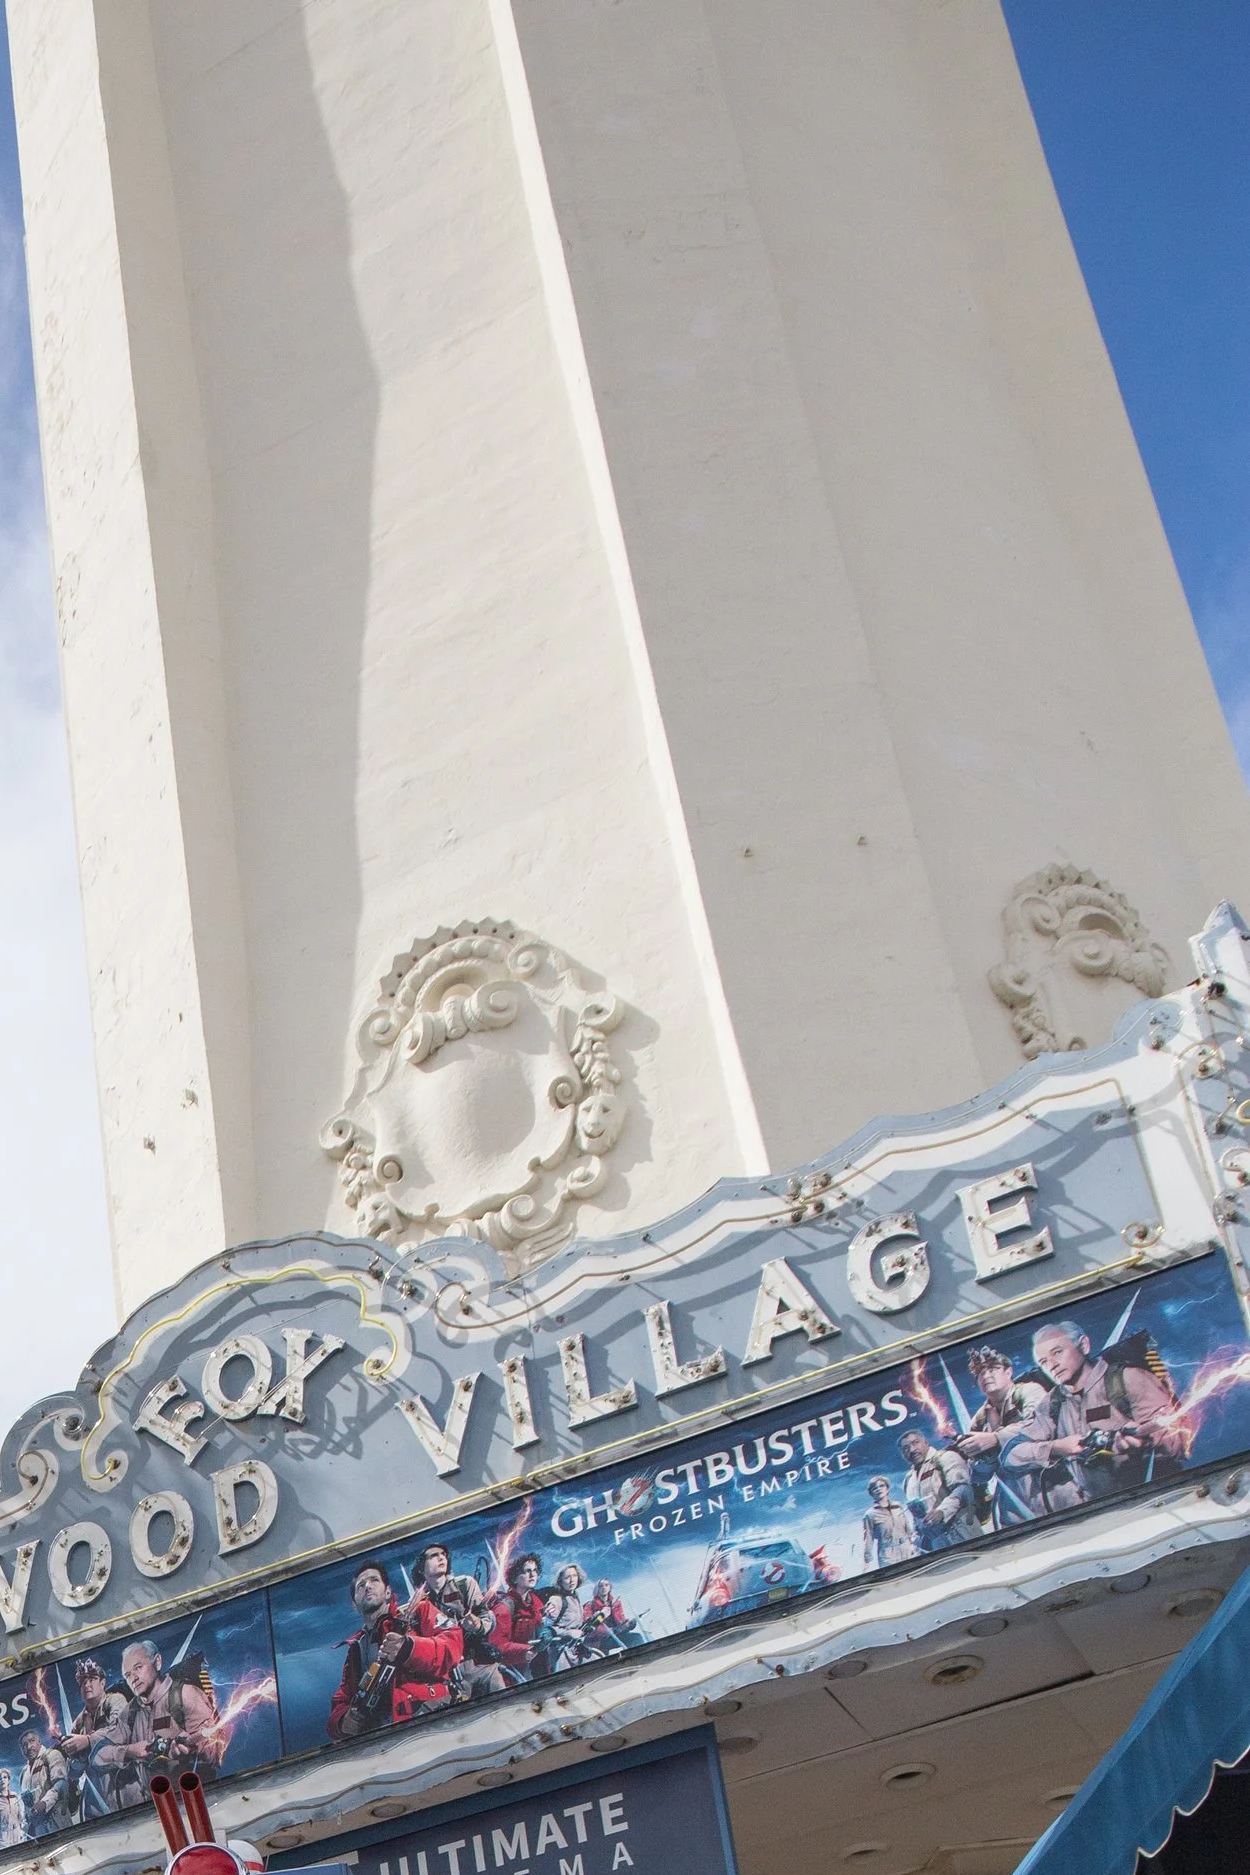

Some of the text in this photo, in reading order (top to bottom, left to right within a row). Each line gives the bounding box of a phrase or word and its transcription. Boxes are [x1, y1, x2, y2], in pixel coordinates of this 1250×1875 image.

[395, 1162, 1054, 1478] VILLAGE
[134, 1328, 346, 1465] FOX
[551, 1389, 908, 1538] GHOSTBUSTERS
[614, 1452, 851, 1546] FROZEN EMPIRE
